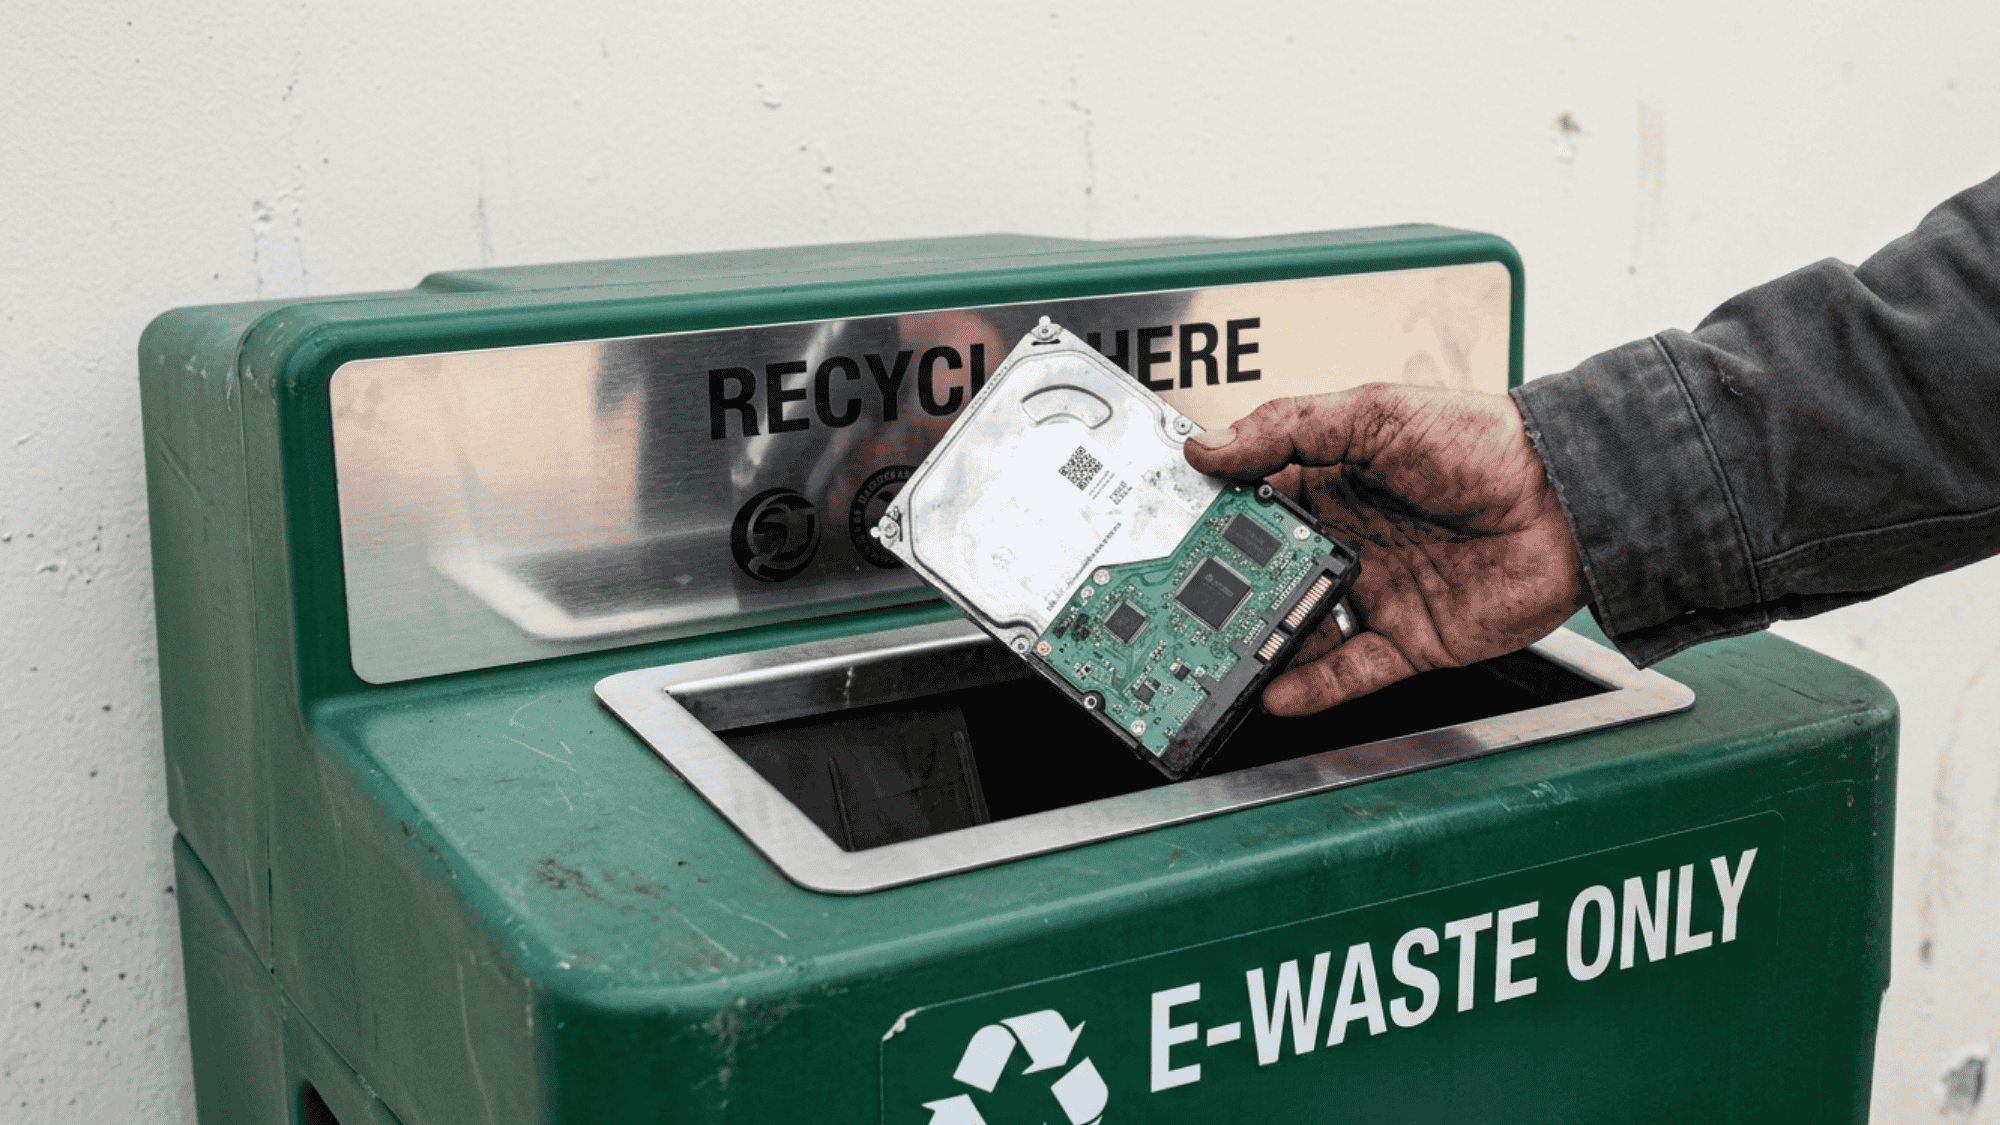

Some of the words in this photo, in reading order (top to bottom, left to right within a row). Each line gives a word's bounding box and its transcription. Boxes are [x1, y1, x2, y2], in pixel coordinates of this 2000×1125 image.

[708, 344, 985, 440] RECYC
[1151, 901, 1540, 1093] E-WASTE
[1566, 848, 1758, 982] ONLY
